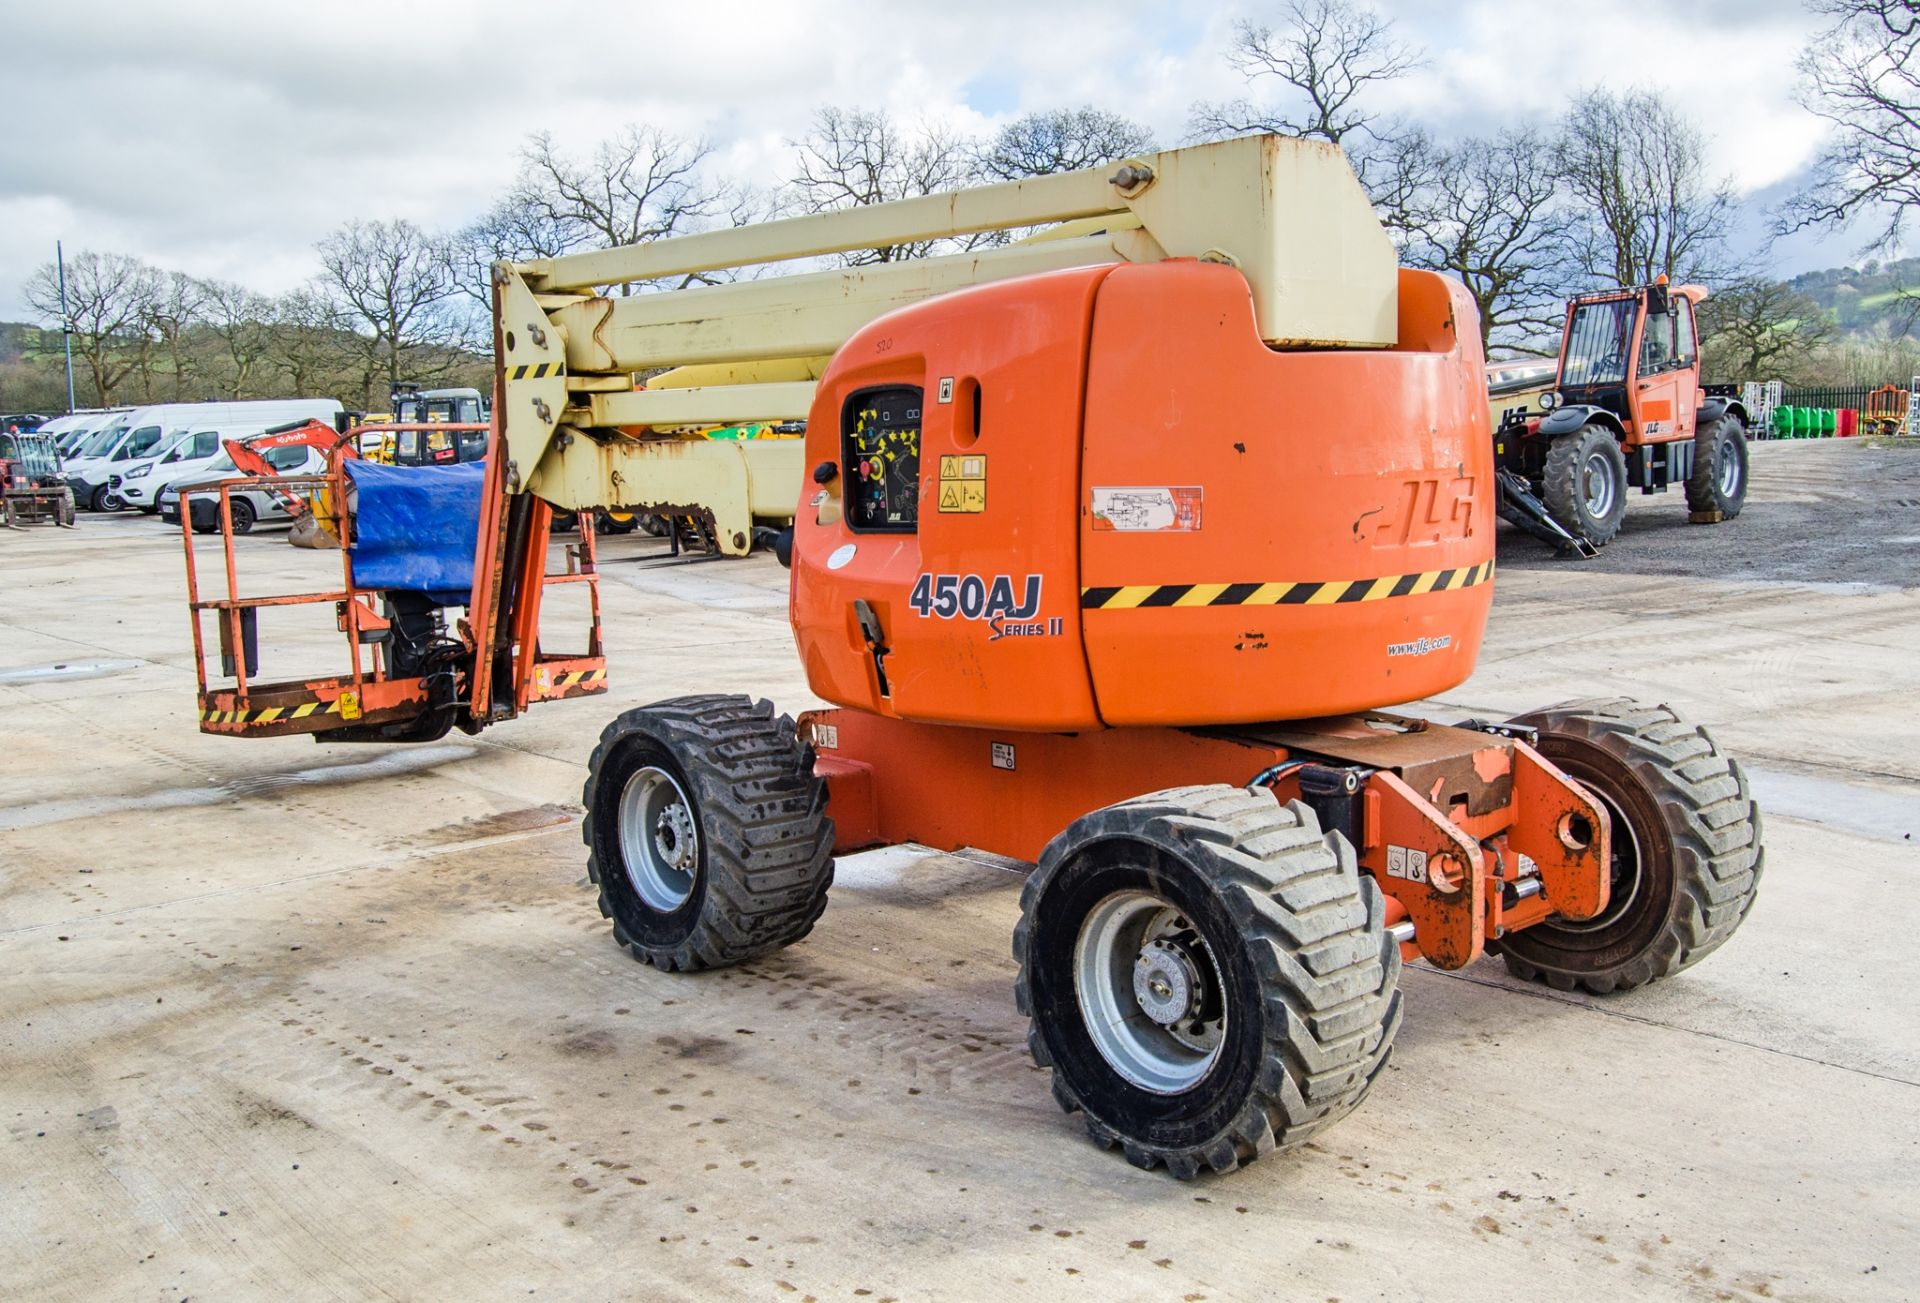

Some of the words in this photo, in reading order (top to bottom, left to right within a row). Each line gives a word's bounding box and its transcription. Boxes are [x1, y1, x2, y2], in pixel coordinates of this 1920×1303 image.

[276, 432, 307, 444] Kubota
[1645, 422, 1660, 435] JLG
[1371, 475, 1475, 550] JLG
[909, 572, 1044, 622] 450AJ
[1048, 617, 1064, 636] II
[1387, 635, 1452, 656] www.jlg.com
